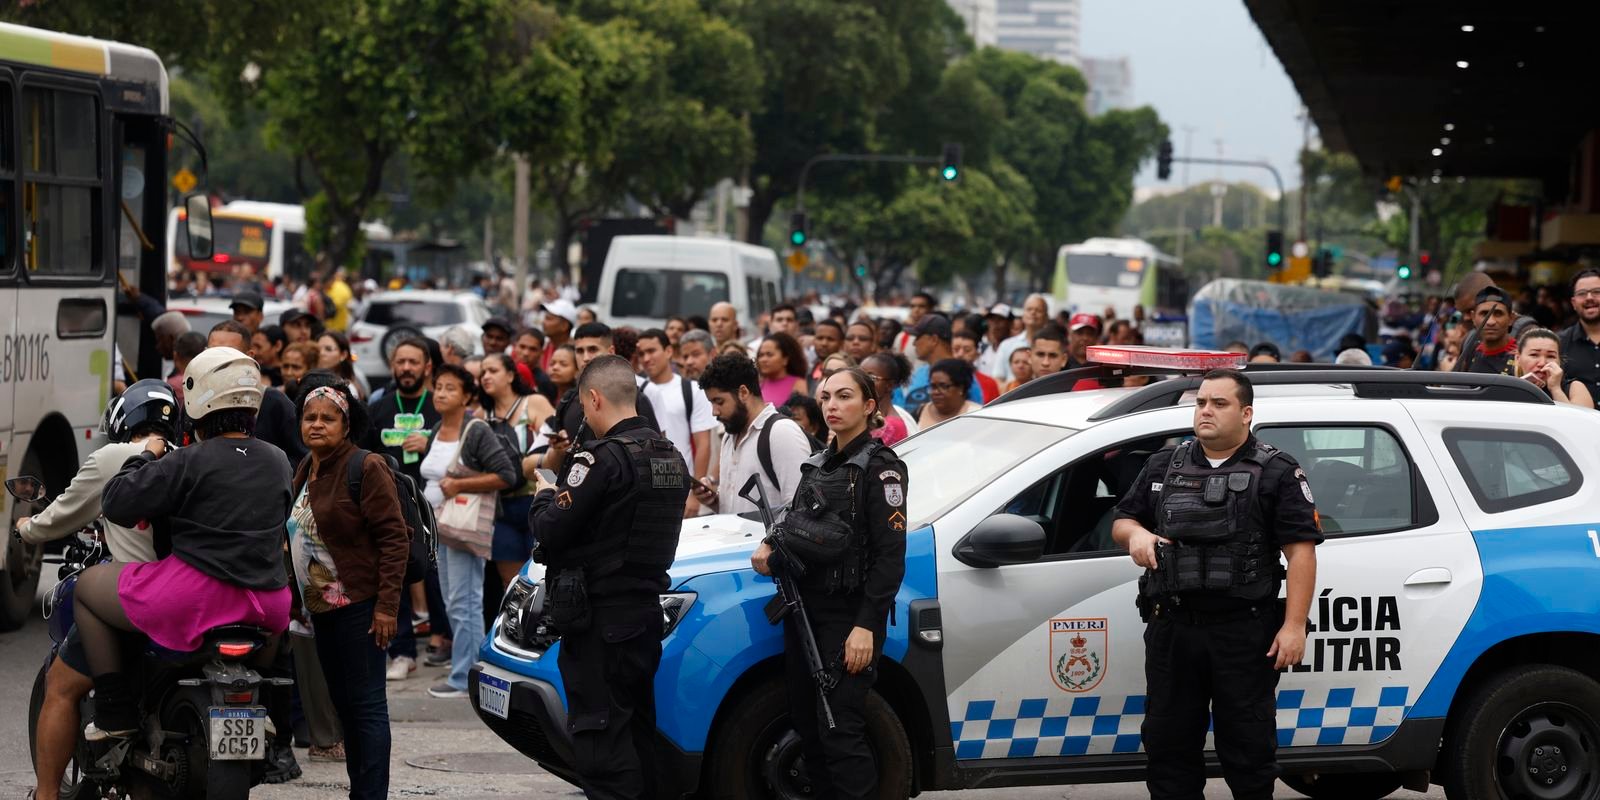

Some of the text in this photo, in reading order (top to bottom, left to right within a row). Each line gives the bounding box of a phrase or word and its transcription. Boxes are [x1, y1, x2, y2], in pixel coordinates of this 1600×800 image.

[654, 475, 682, 486] MILITAR
[1308, 588, 1401, 632] ÍCIA
[1053, 621, 1104, 630] PMERJ
[1281, 637, 1402, 673] ITAR
[223, 719, 254, 736] SSB
[218, 737, 259, 754] 6C59
